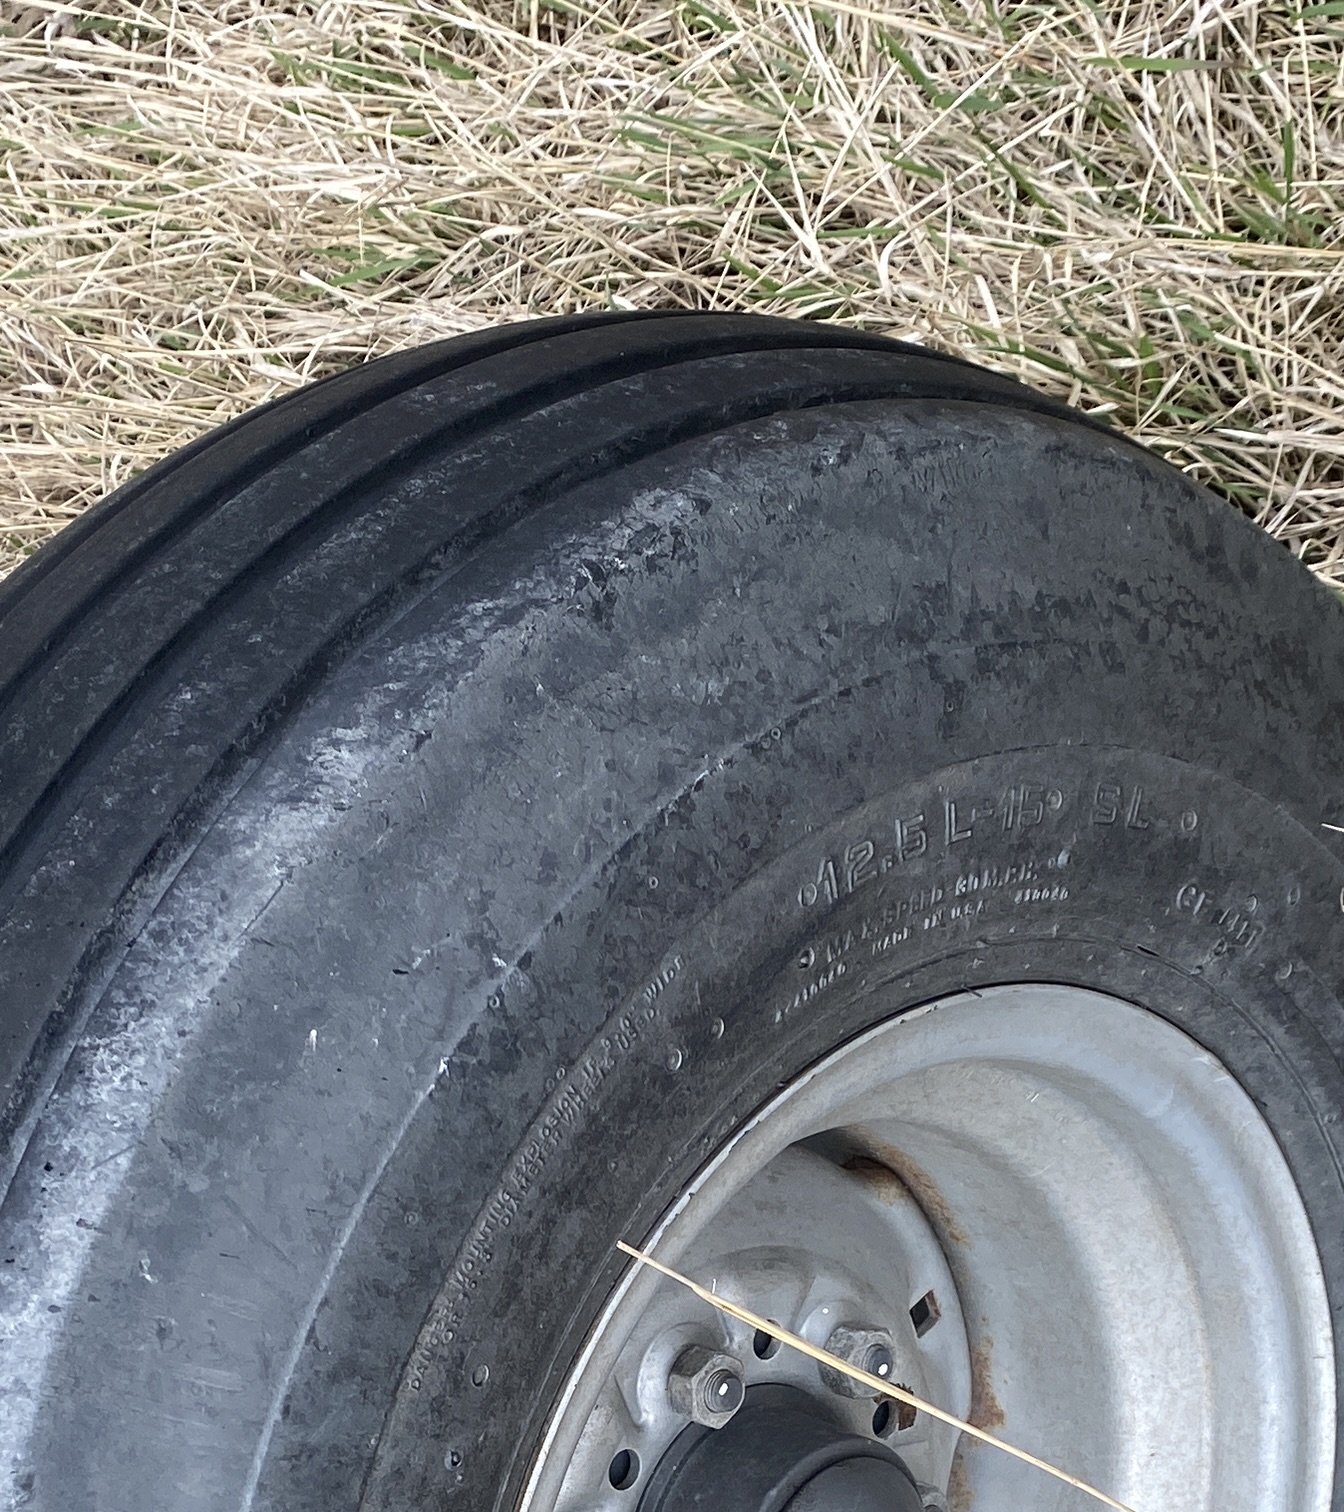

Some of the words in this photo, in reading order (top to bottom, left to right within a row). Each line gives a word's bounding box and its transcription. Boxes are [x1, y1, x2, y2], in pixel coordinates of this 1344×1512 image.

[1091, 781, 1149, 831] SL
[499, 1129, 562, 1227] DIAMETER
[509, 1084, 578, 1184] EXPLOSION
